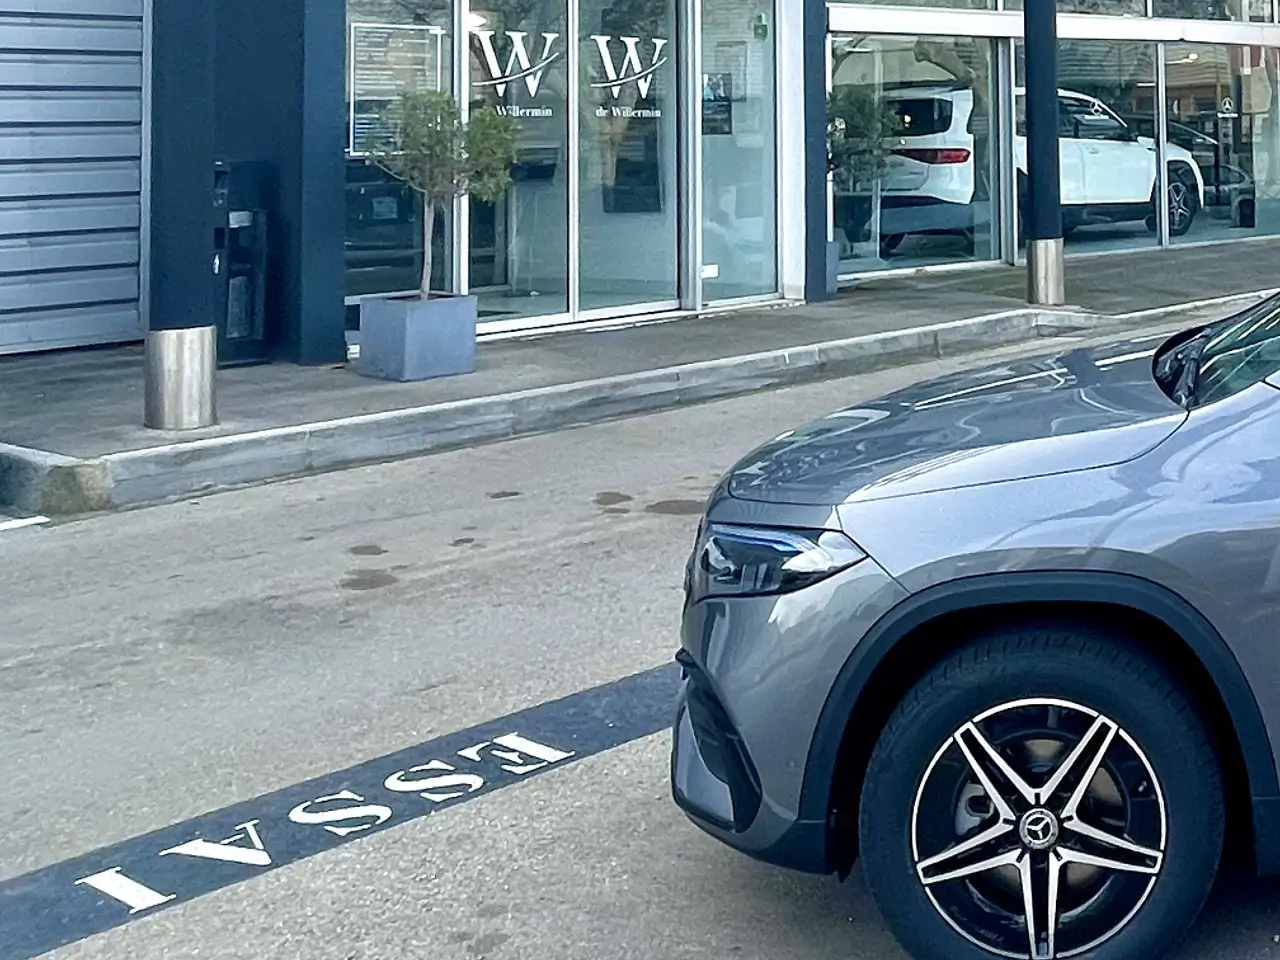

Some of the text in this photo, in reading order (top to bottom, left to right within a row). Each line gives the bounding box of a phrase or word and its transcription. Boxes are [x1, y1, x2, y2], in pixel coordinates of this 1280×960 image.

[469, 30, 560, 98] W
[590, 35, 668, 99] W
[74, 731, 576, 915] ESSAI
